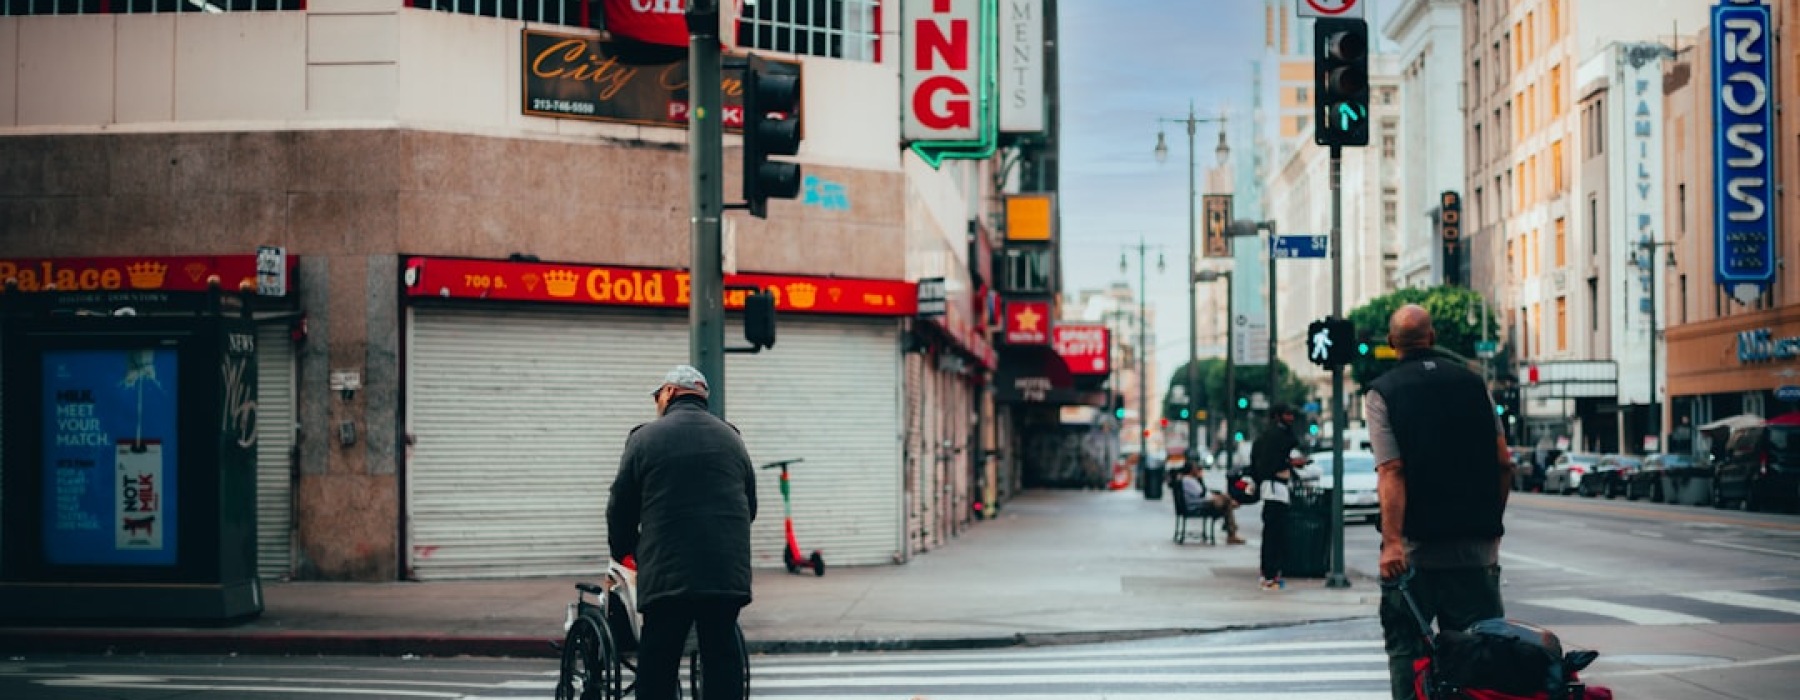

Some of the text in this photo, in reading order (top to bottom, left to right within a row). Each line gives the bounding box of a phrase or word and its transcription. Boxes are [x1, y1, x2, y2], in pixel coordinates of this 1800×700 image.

[532, 39, 638, 100] City
[912, 0, 971, 130] NG
[1635, 79, 1651, 200] FAMILY
[1722, 18, 1766, 222] ROSS
[0, 261, 122, 291] Palace
[586, 269, 665, 303] Gold
[123, 475, 138, 512] NOT
[139, 473, 152, 512] MILK
